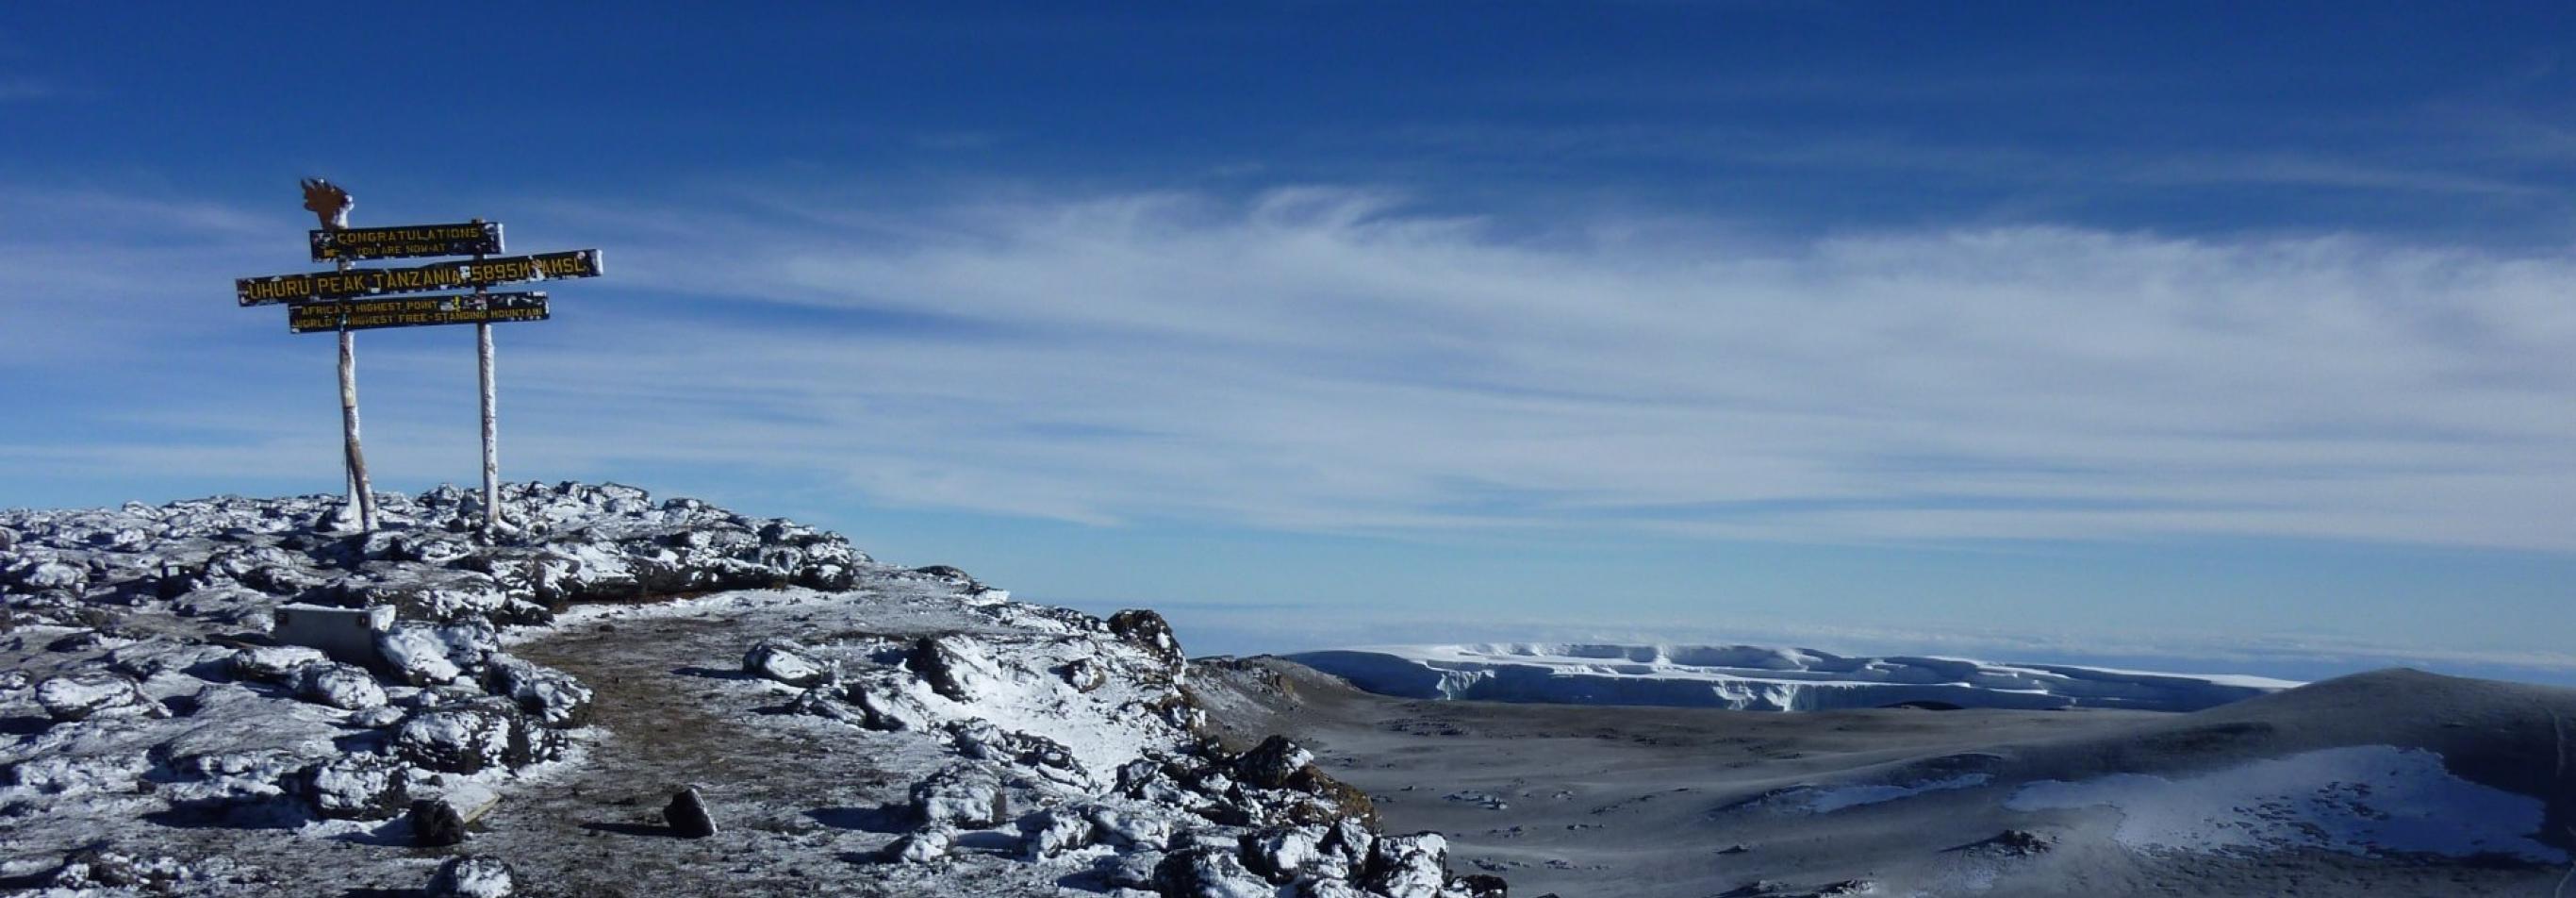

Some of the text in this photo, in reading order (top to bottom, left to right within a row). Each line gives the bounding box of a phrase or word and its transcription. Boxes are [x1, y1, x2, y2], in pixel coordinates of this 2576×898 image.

[338, 227, 479, 245] CONGRATULATIONS
[355, 246, 376, 256] YOU
[381, 244, 401, 255] ARE
[249, 278, 310, 300] UHURU
[318, 274, 366, 293] PEAK
[373, 268, 461, 288] TANZANIA
[471, 261, 529, 281] 5895M
[302, 299, 438, 316] AFRICA'S HIGHEST POINT
